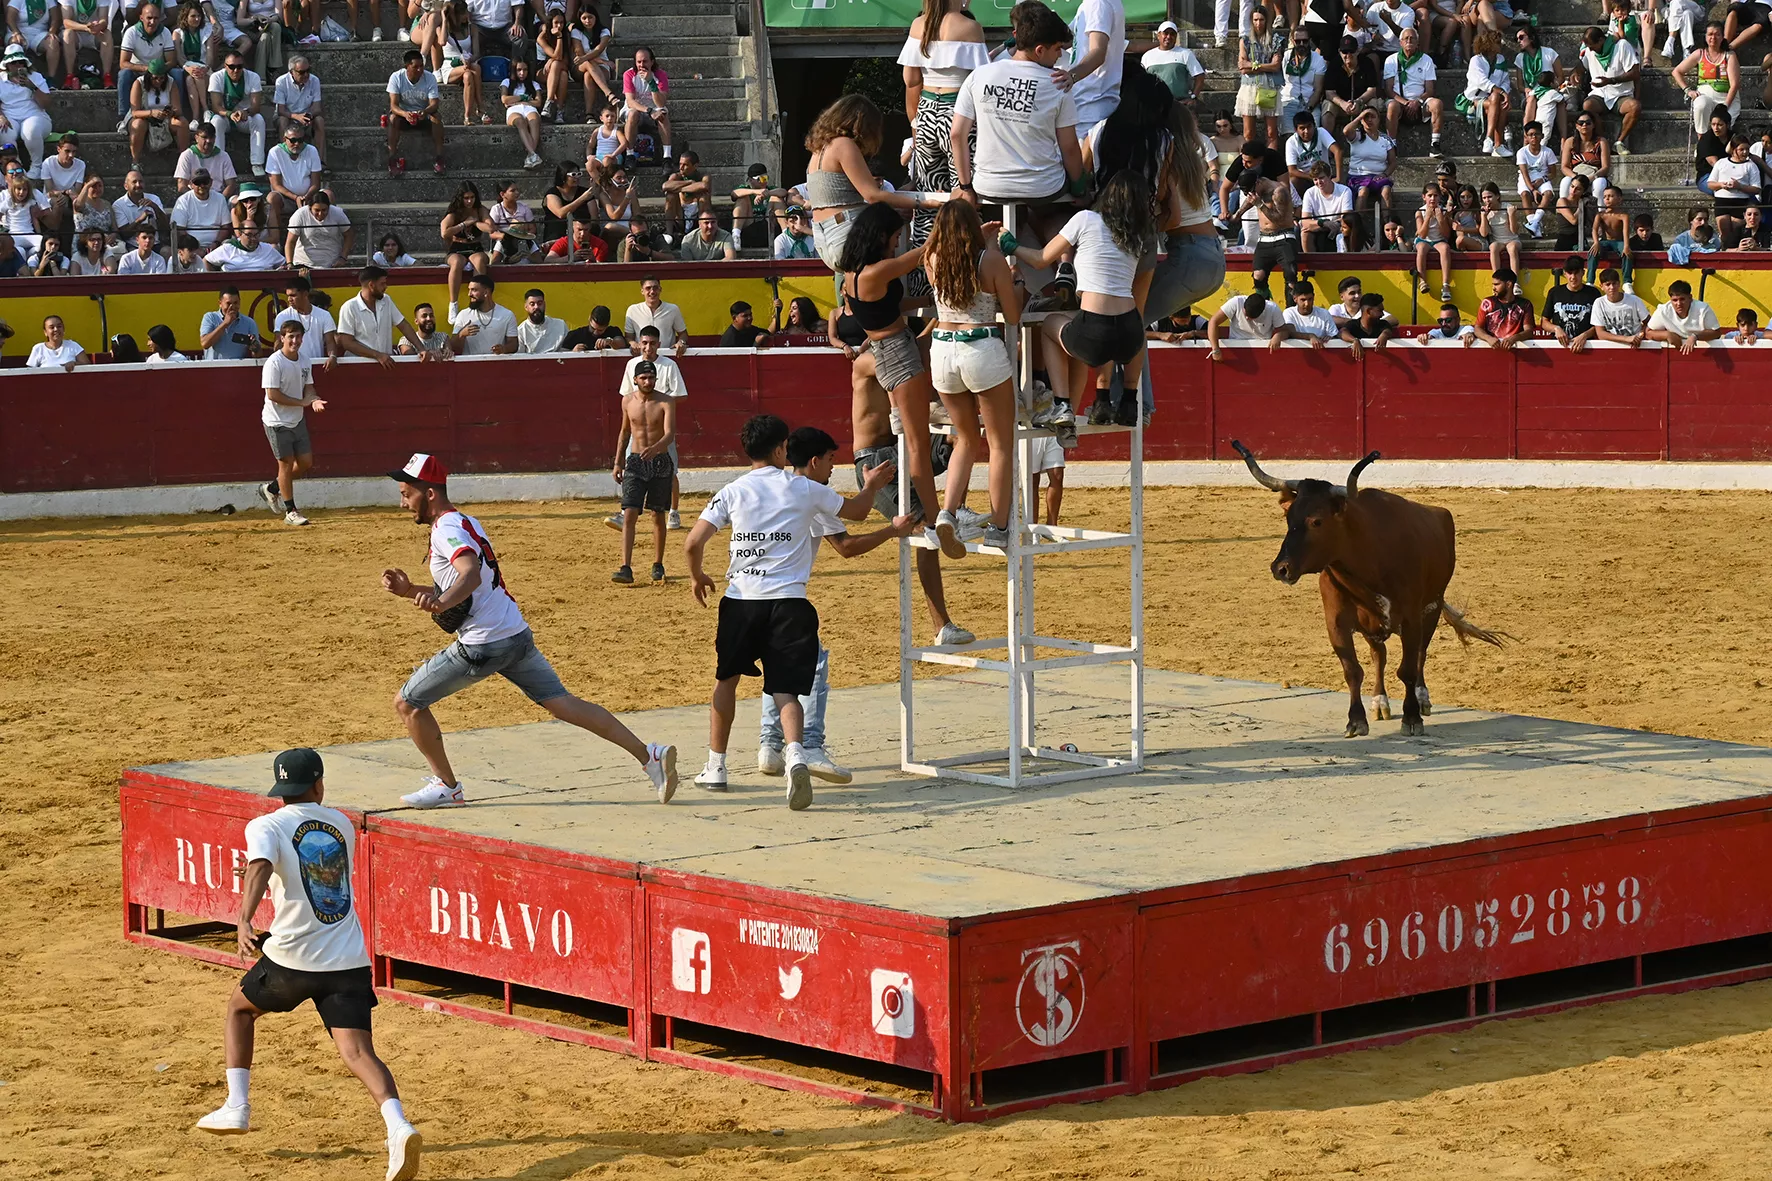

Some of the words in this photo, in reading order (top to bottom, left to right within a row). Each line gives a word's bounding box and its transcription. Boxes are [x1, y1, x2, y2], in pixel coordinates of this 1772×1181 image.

[1010, 77, 1038, 91] THE
[983, 84, 1036, 101] NORTH
[997, 98, 1032, 113] FACE
[730, 533, 766, 541] ISHED
[769, 532, 792, 541] 1856
[736, 549, 766, 558] ROAD
[279, 764, 288, 779] LA
[322, 823, 344, 843] COMO
[316, 910, 344, 922] ITALIA
[429, 887, 573, 958] BRAVO
[1324, 876, 1641, 974] 696052858
[748, 919, 780, 948] PATENTE
